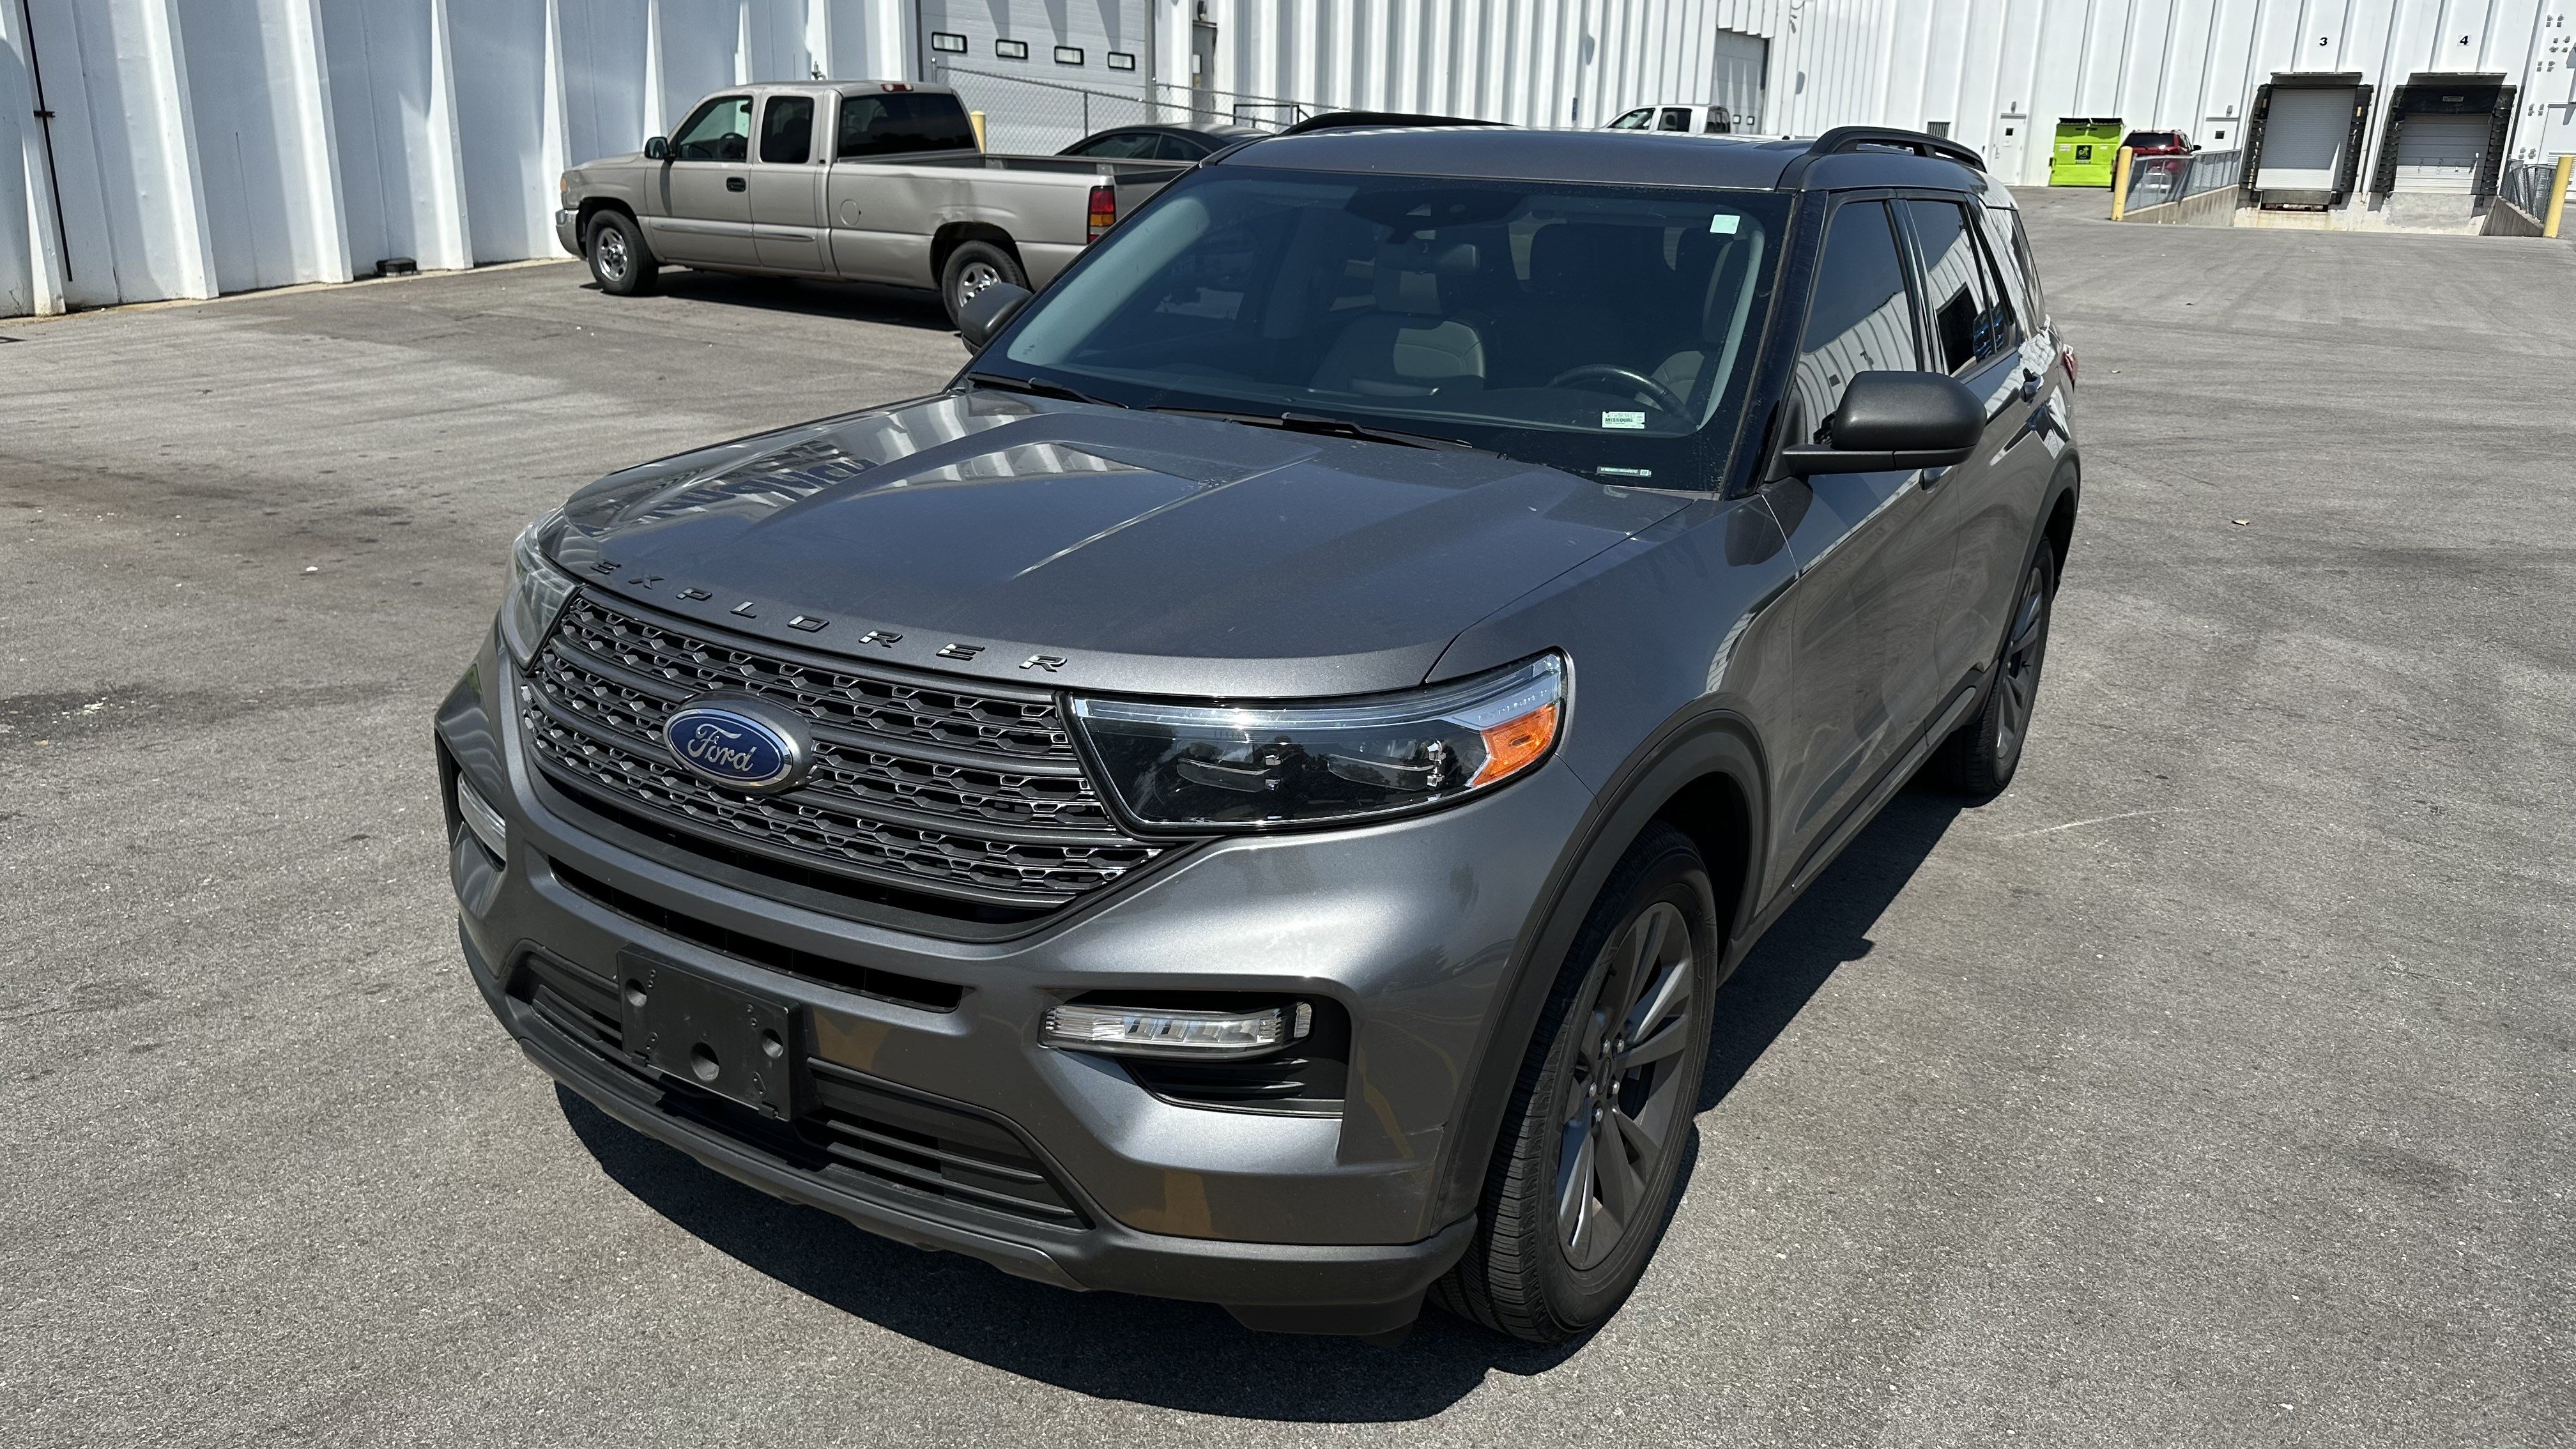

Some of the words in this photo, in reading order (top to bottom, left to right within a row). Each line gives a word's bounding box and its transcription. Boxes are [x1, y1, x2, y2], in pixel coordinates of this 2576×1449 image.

[2319, 36, 2328, 47] 3
[2459, 35, 2469, 45] 4
[589, 558, 1068, 673] EXPLORER
[687, 723, 758, 772] Ford
